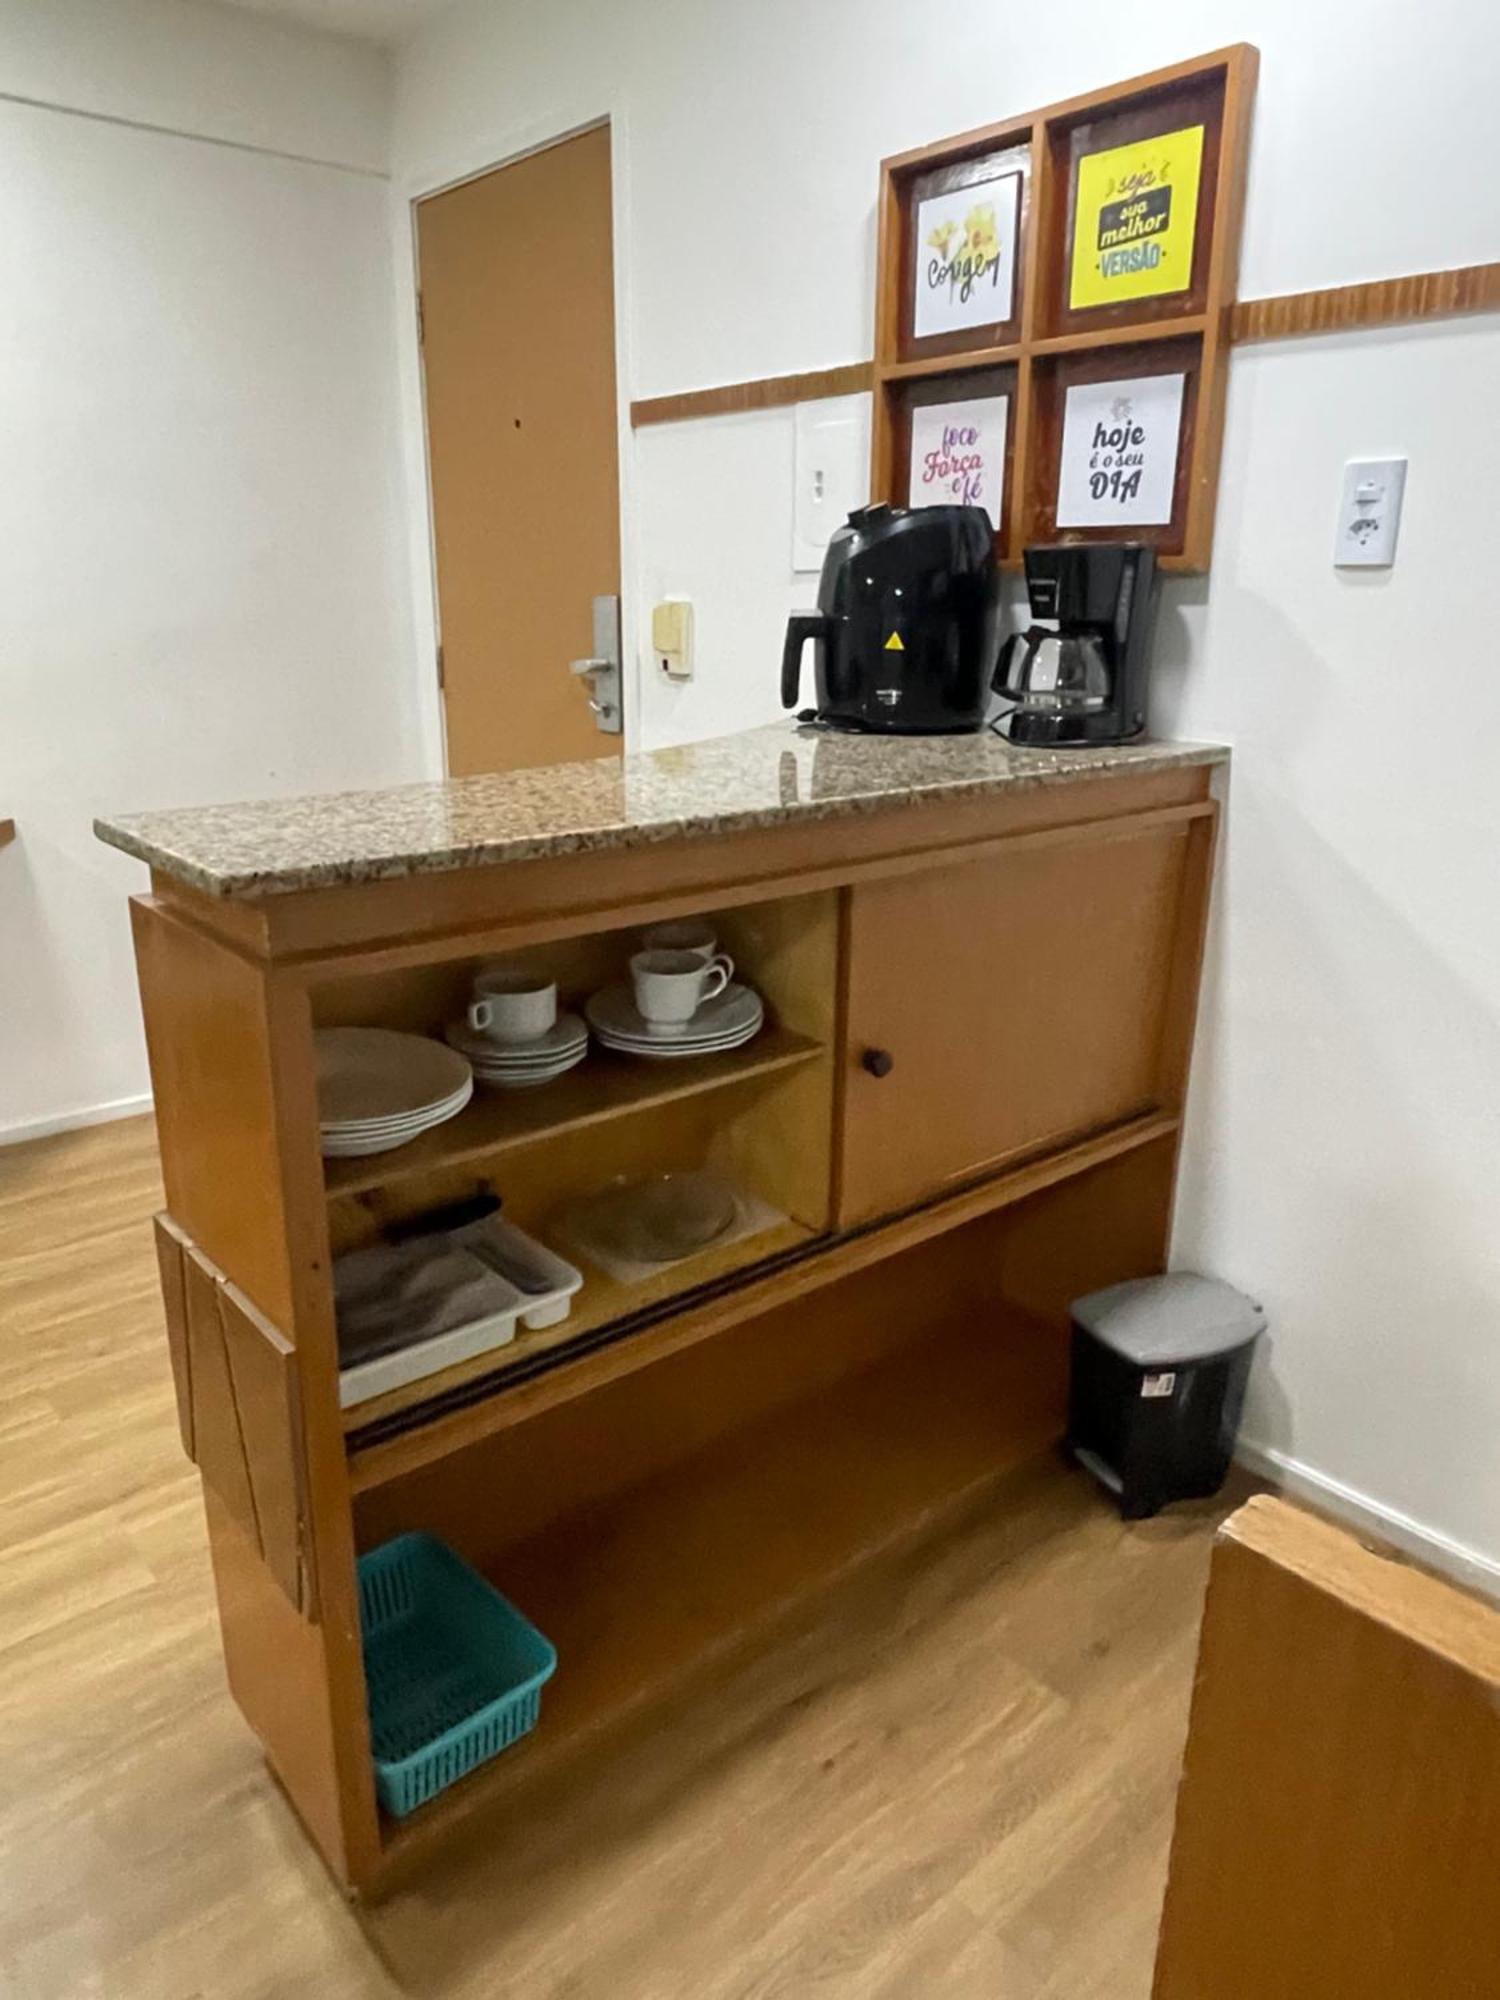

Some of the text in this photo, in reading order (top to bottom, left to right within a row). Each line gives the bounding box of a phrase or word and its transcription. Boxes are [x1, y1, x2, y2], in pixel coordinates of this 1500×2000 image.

[1118, 163, 1156, 203] seja
[1120, 201, 1148, 220] sua
[1101, 212, 1168, 247] melhor
[1102, 241, 1161, 278] VERSÃO
[942, 426, 979, 459] foco
[1092, 419, 1145, 453] hoje
[922, 450, 983, 483] Força
[1089, 451, 1144, 469] é o seu
[962, 473, 982, 506] fé
[1089, 469, 1143, 503] DIA
